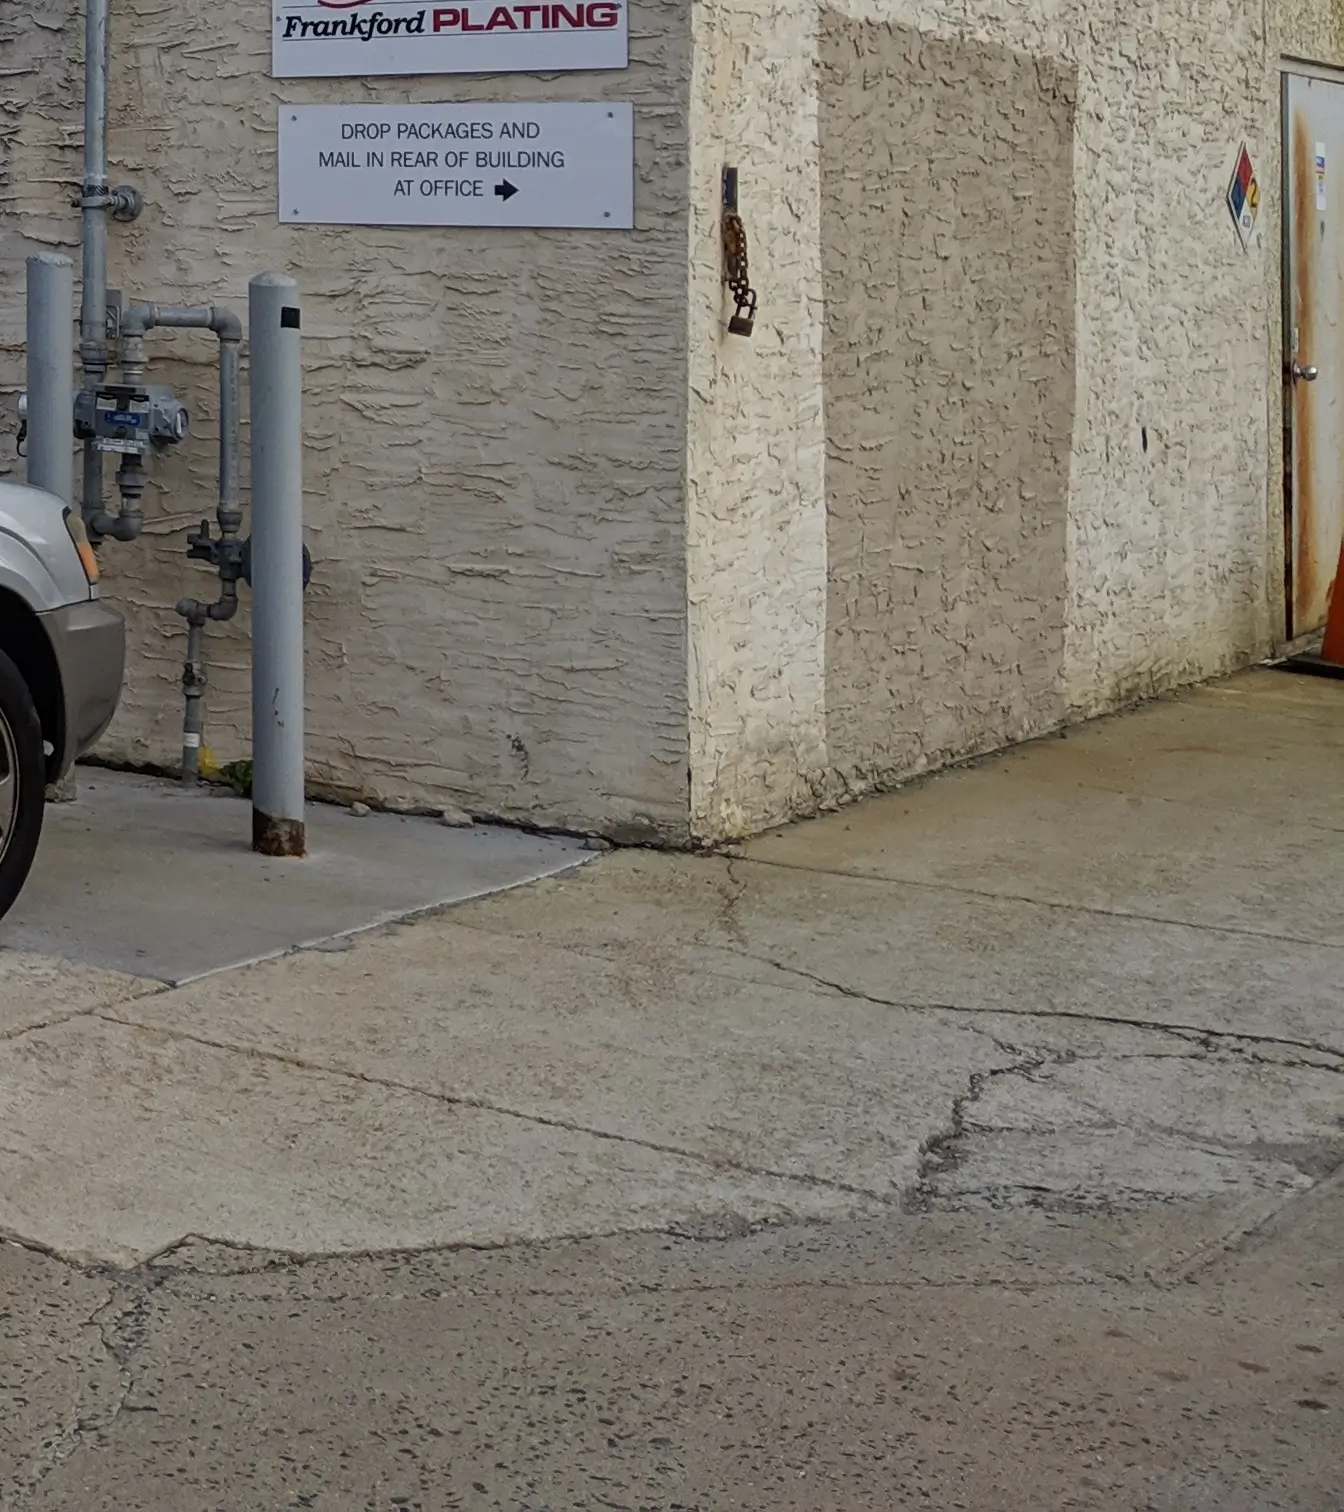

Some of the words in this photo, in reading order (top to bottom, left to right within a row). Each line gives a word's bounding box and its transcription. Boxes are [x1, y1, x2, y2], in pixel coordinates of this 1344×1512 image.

[282, 11, 425, 43] Frankford
[432, 2, 619, 33] PLATING
[340, 122, 392, 141] DROP
[397, 122, 494, 140] PACKAGES
[500, 121, 541, 139] AND
[318, 151, 361, 169] MAIL
[366, 151, 384, 168] IN
[390, 151, 439, 168] REAR
[444, 151, 470, 168] OF
[475, 150, 565, 168] BUILDING
[393, 180, 415, 197] AT
[419, 179, 484, 197] OFFICE
